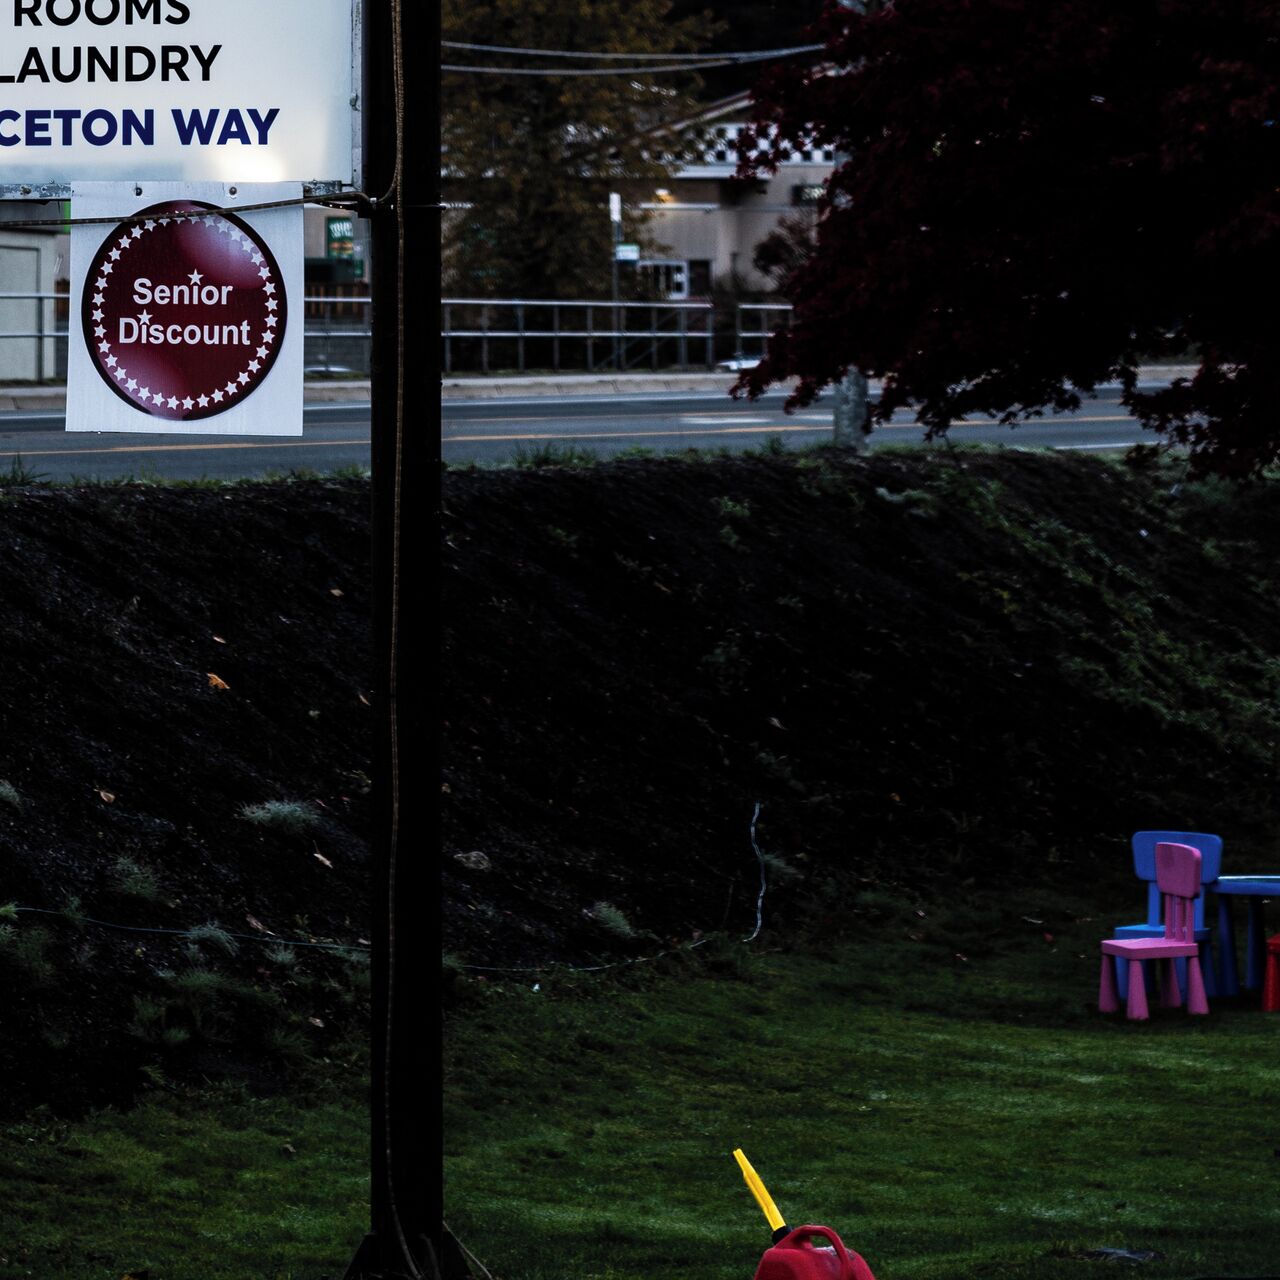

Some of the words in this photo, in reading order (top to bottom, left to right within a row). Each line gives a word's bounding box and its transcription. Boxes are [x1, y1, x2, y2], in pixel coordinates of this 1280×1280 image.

[170, 108, 281, 146] WAY
[132, 277, 234, 306] Senior
[119, 316, 252, 346] Discount
